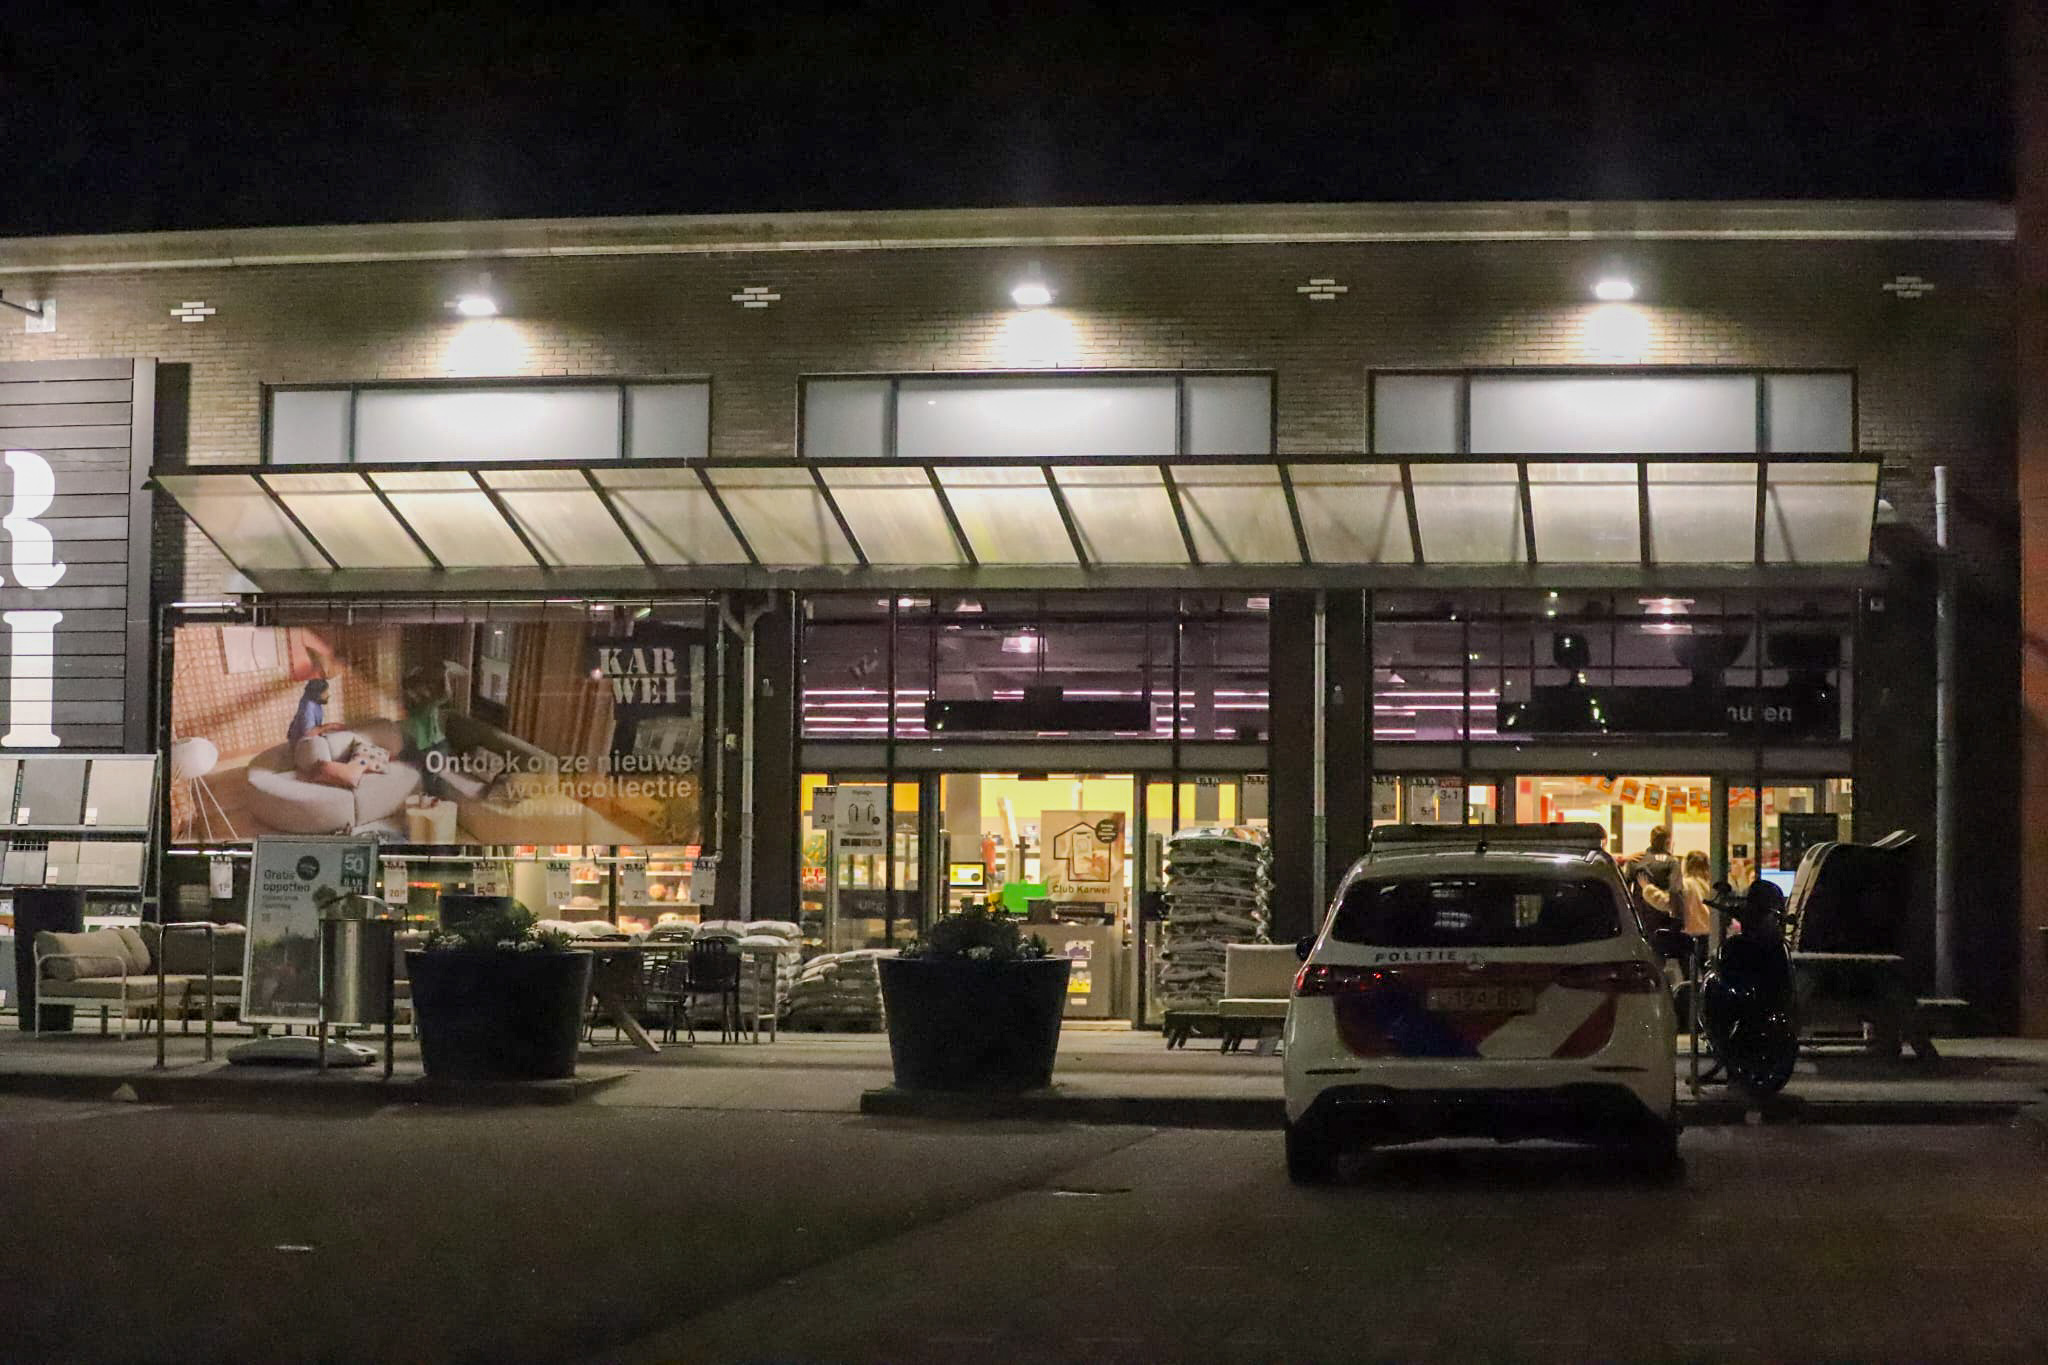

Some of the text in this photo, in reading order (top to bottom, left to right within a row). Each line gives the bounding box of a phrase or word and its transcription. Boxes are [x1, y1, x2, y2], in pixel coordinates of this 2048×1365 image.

[599, 647, 678, 675] KAR
[611, 677, 678, 705] WEI
[426, 750, 693, 774] Ontdek onze nieuwe
[506, 774, 692, 799] wooncollectie
[263, 869, 296, 881] Gratis
[1052, 884, 1111, 894] Club Karwei
[1375, 950, 1457, 963] POLITIE
